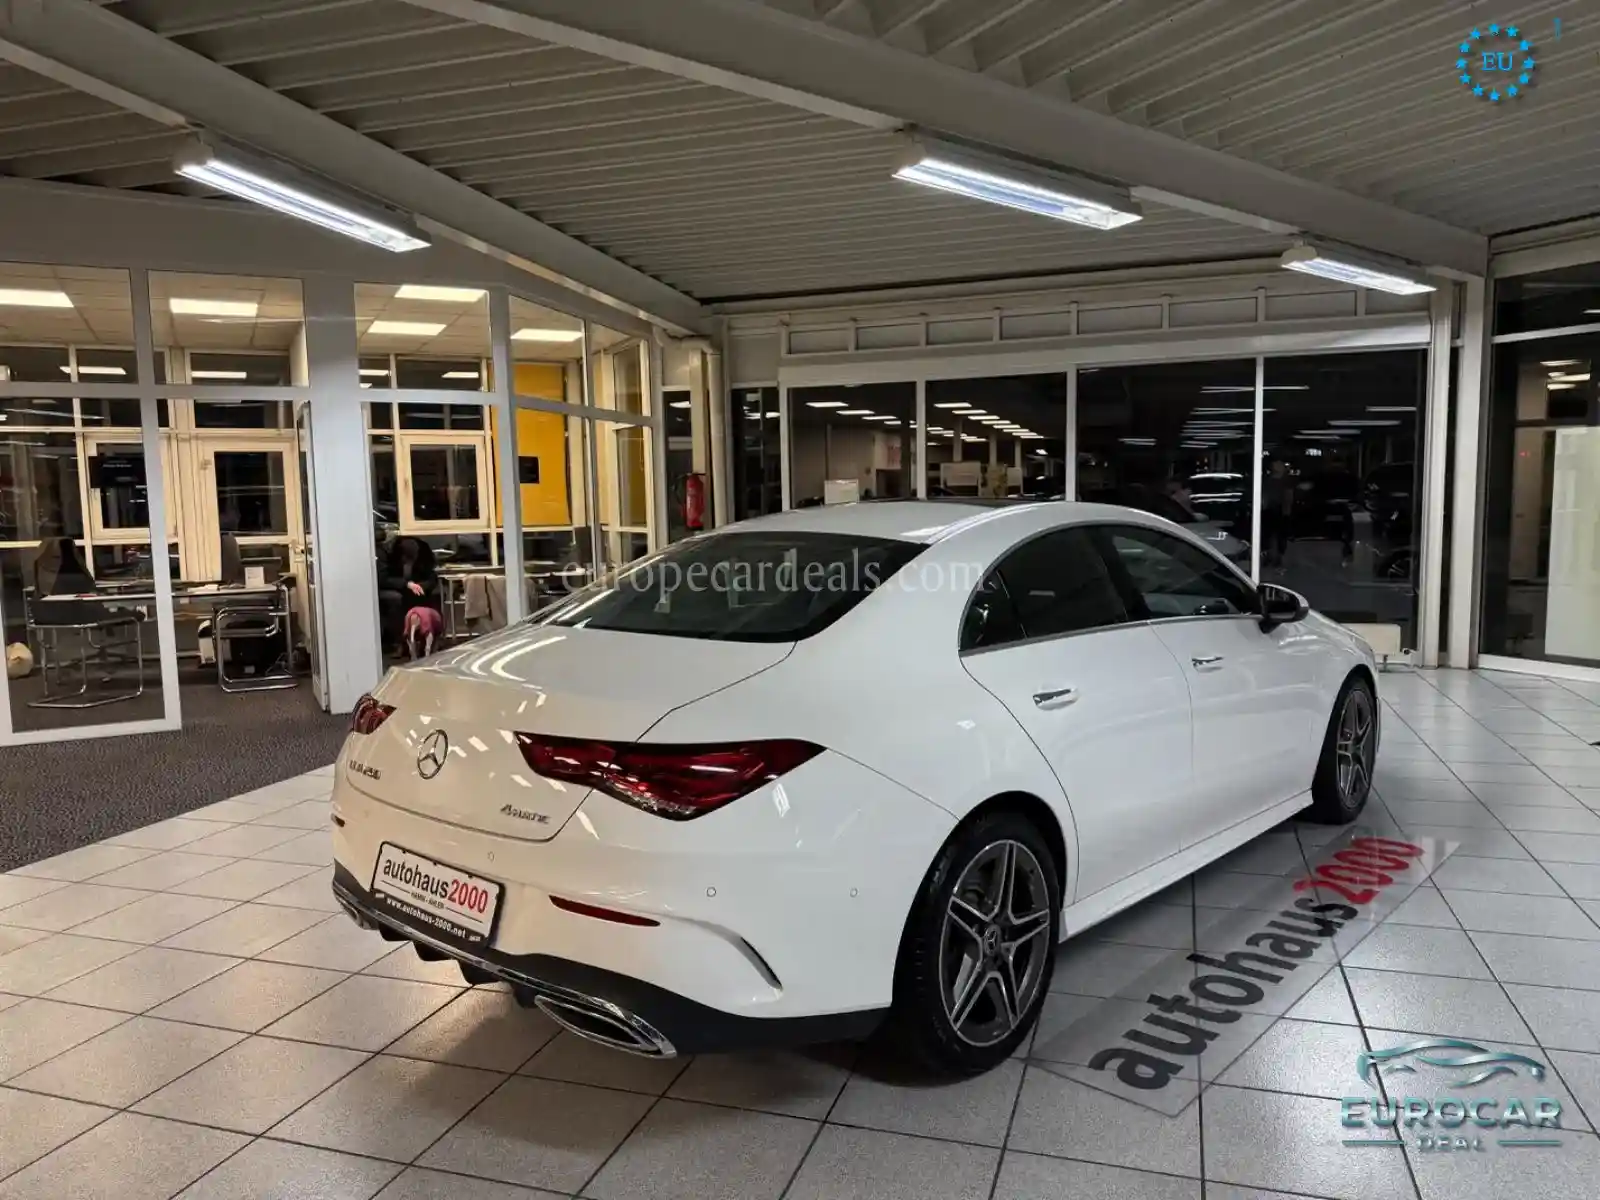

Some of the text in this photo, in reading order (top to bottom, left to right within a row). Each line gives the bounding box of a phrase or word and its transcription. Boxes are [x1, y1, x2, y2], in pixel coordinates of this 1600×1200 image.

[383, 858, 489, 914] autohaus2000
[386, 897, 466, 939] www.autohaus-2000.net
[1088, 837, 1425, 1091] autohaus2000
